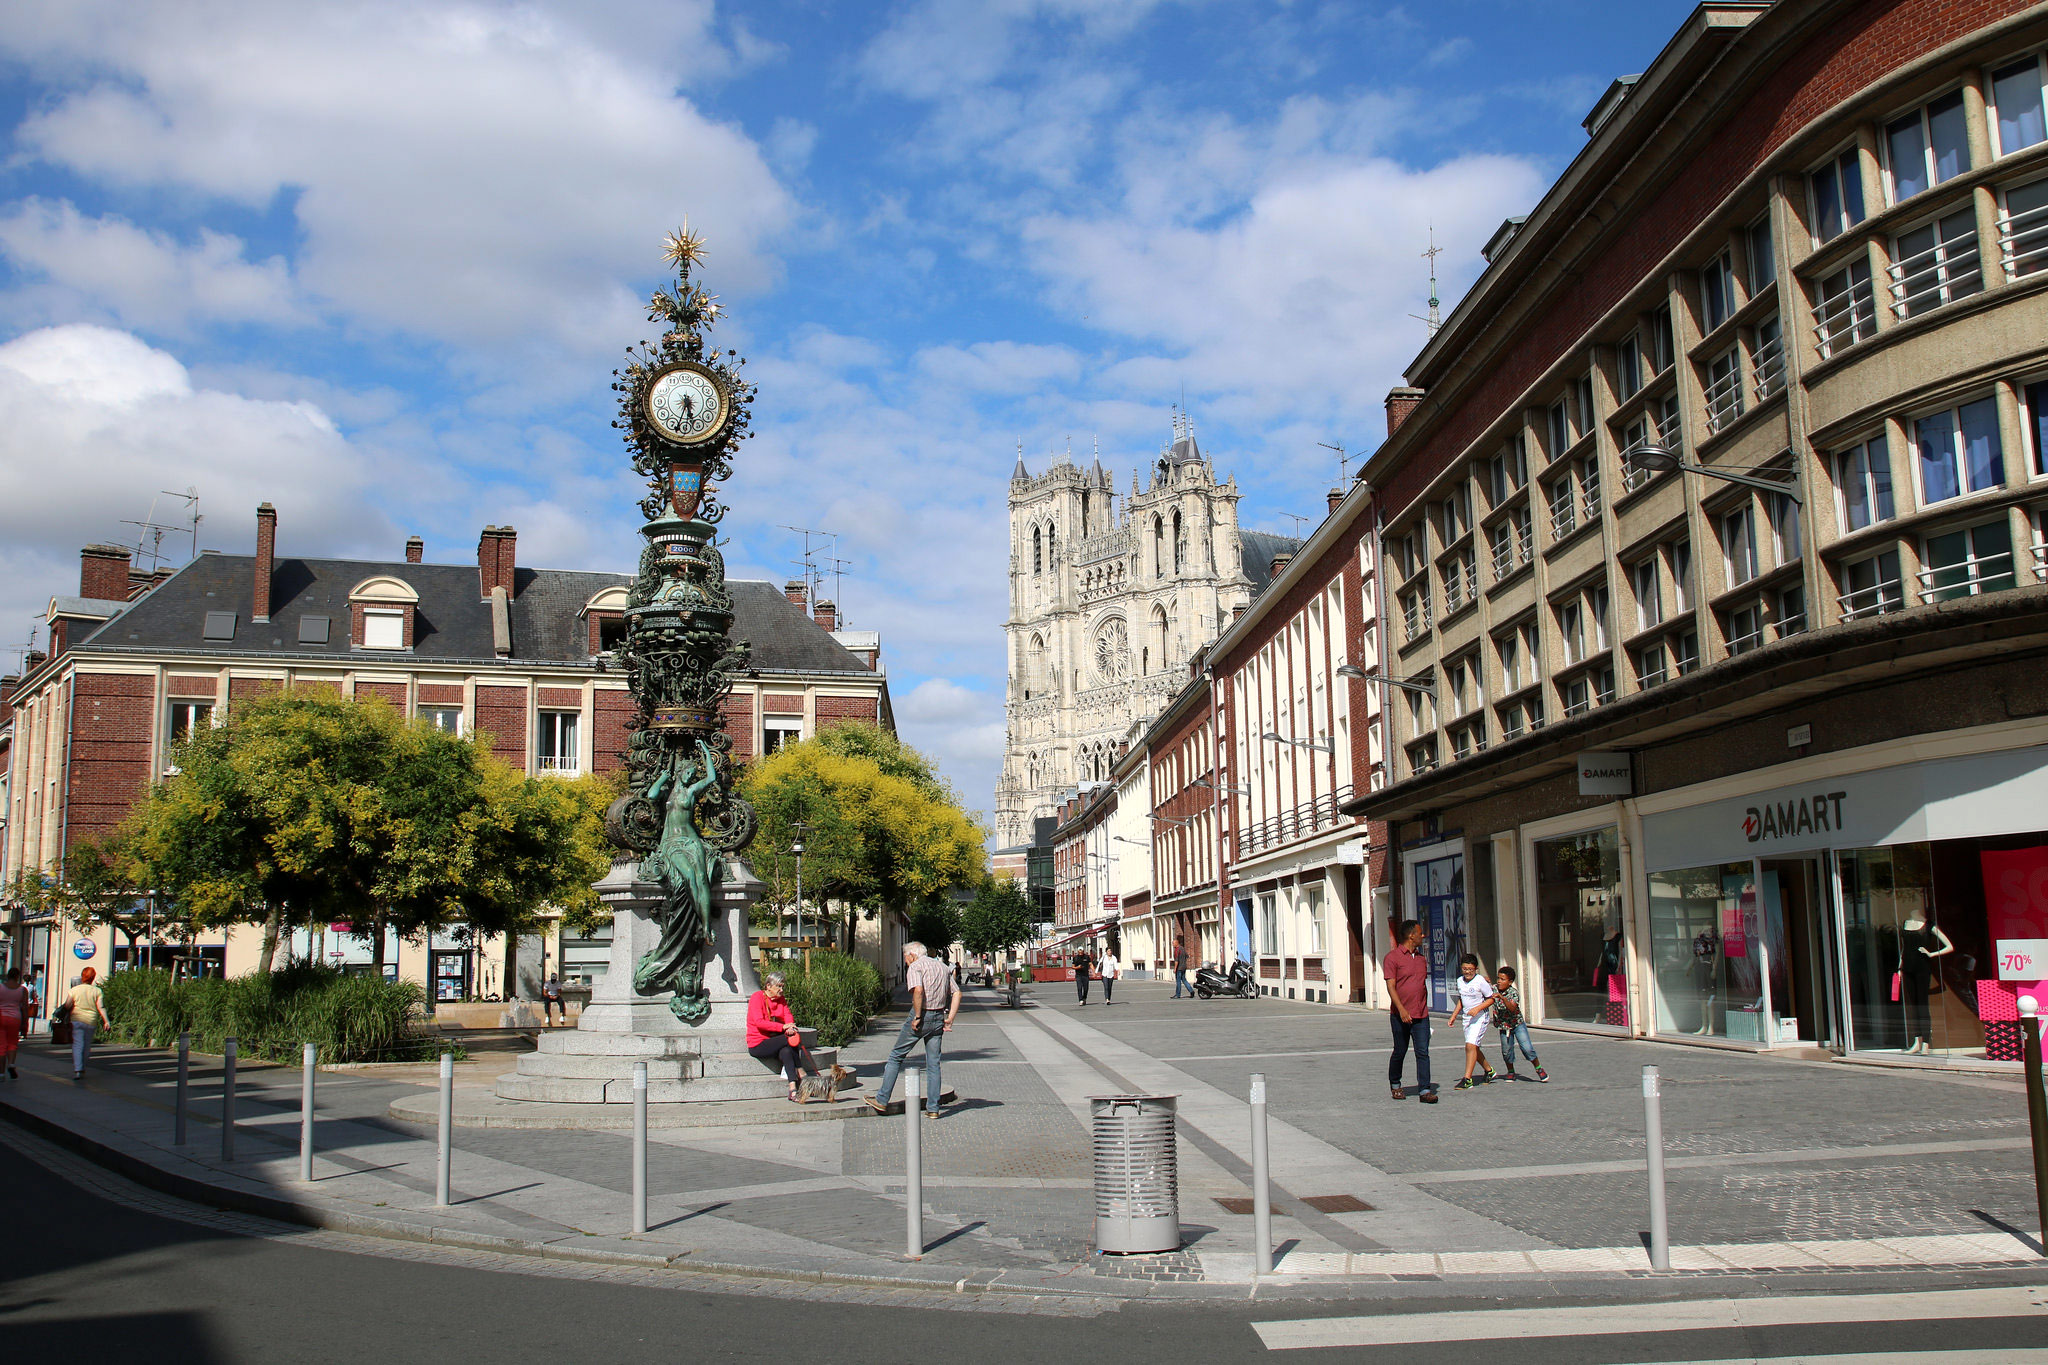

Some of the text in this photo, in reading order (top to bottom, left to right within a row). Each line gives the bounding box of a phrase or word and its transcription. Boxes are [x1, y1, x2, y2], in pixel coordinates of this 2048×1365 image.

[1582, 768, 1630, 779] DAMART
[1741, 791, 1847, 843] DAMART
[1433, 951, 1445, 965] 100
[2000, 954, 2033, 972] -70%
